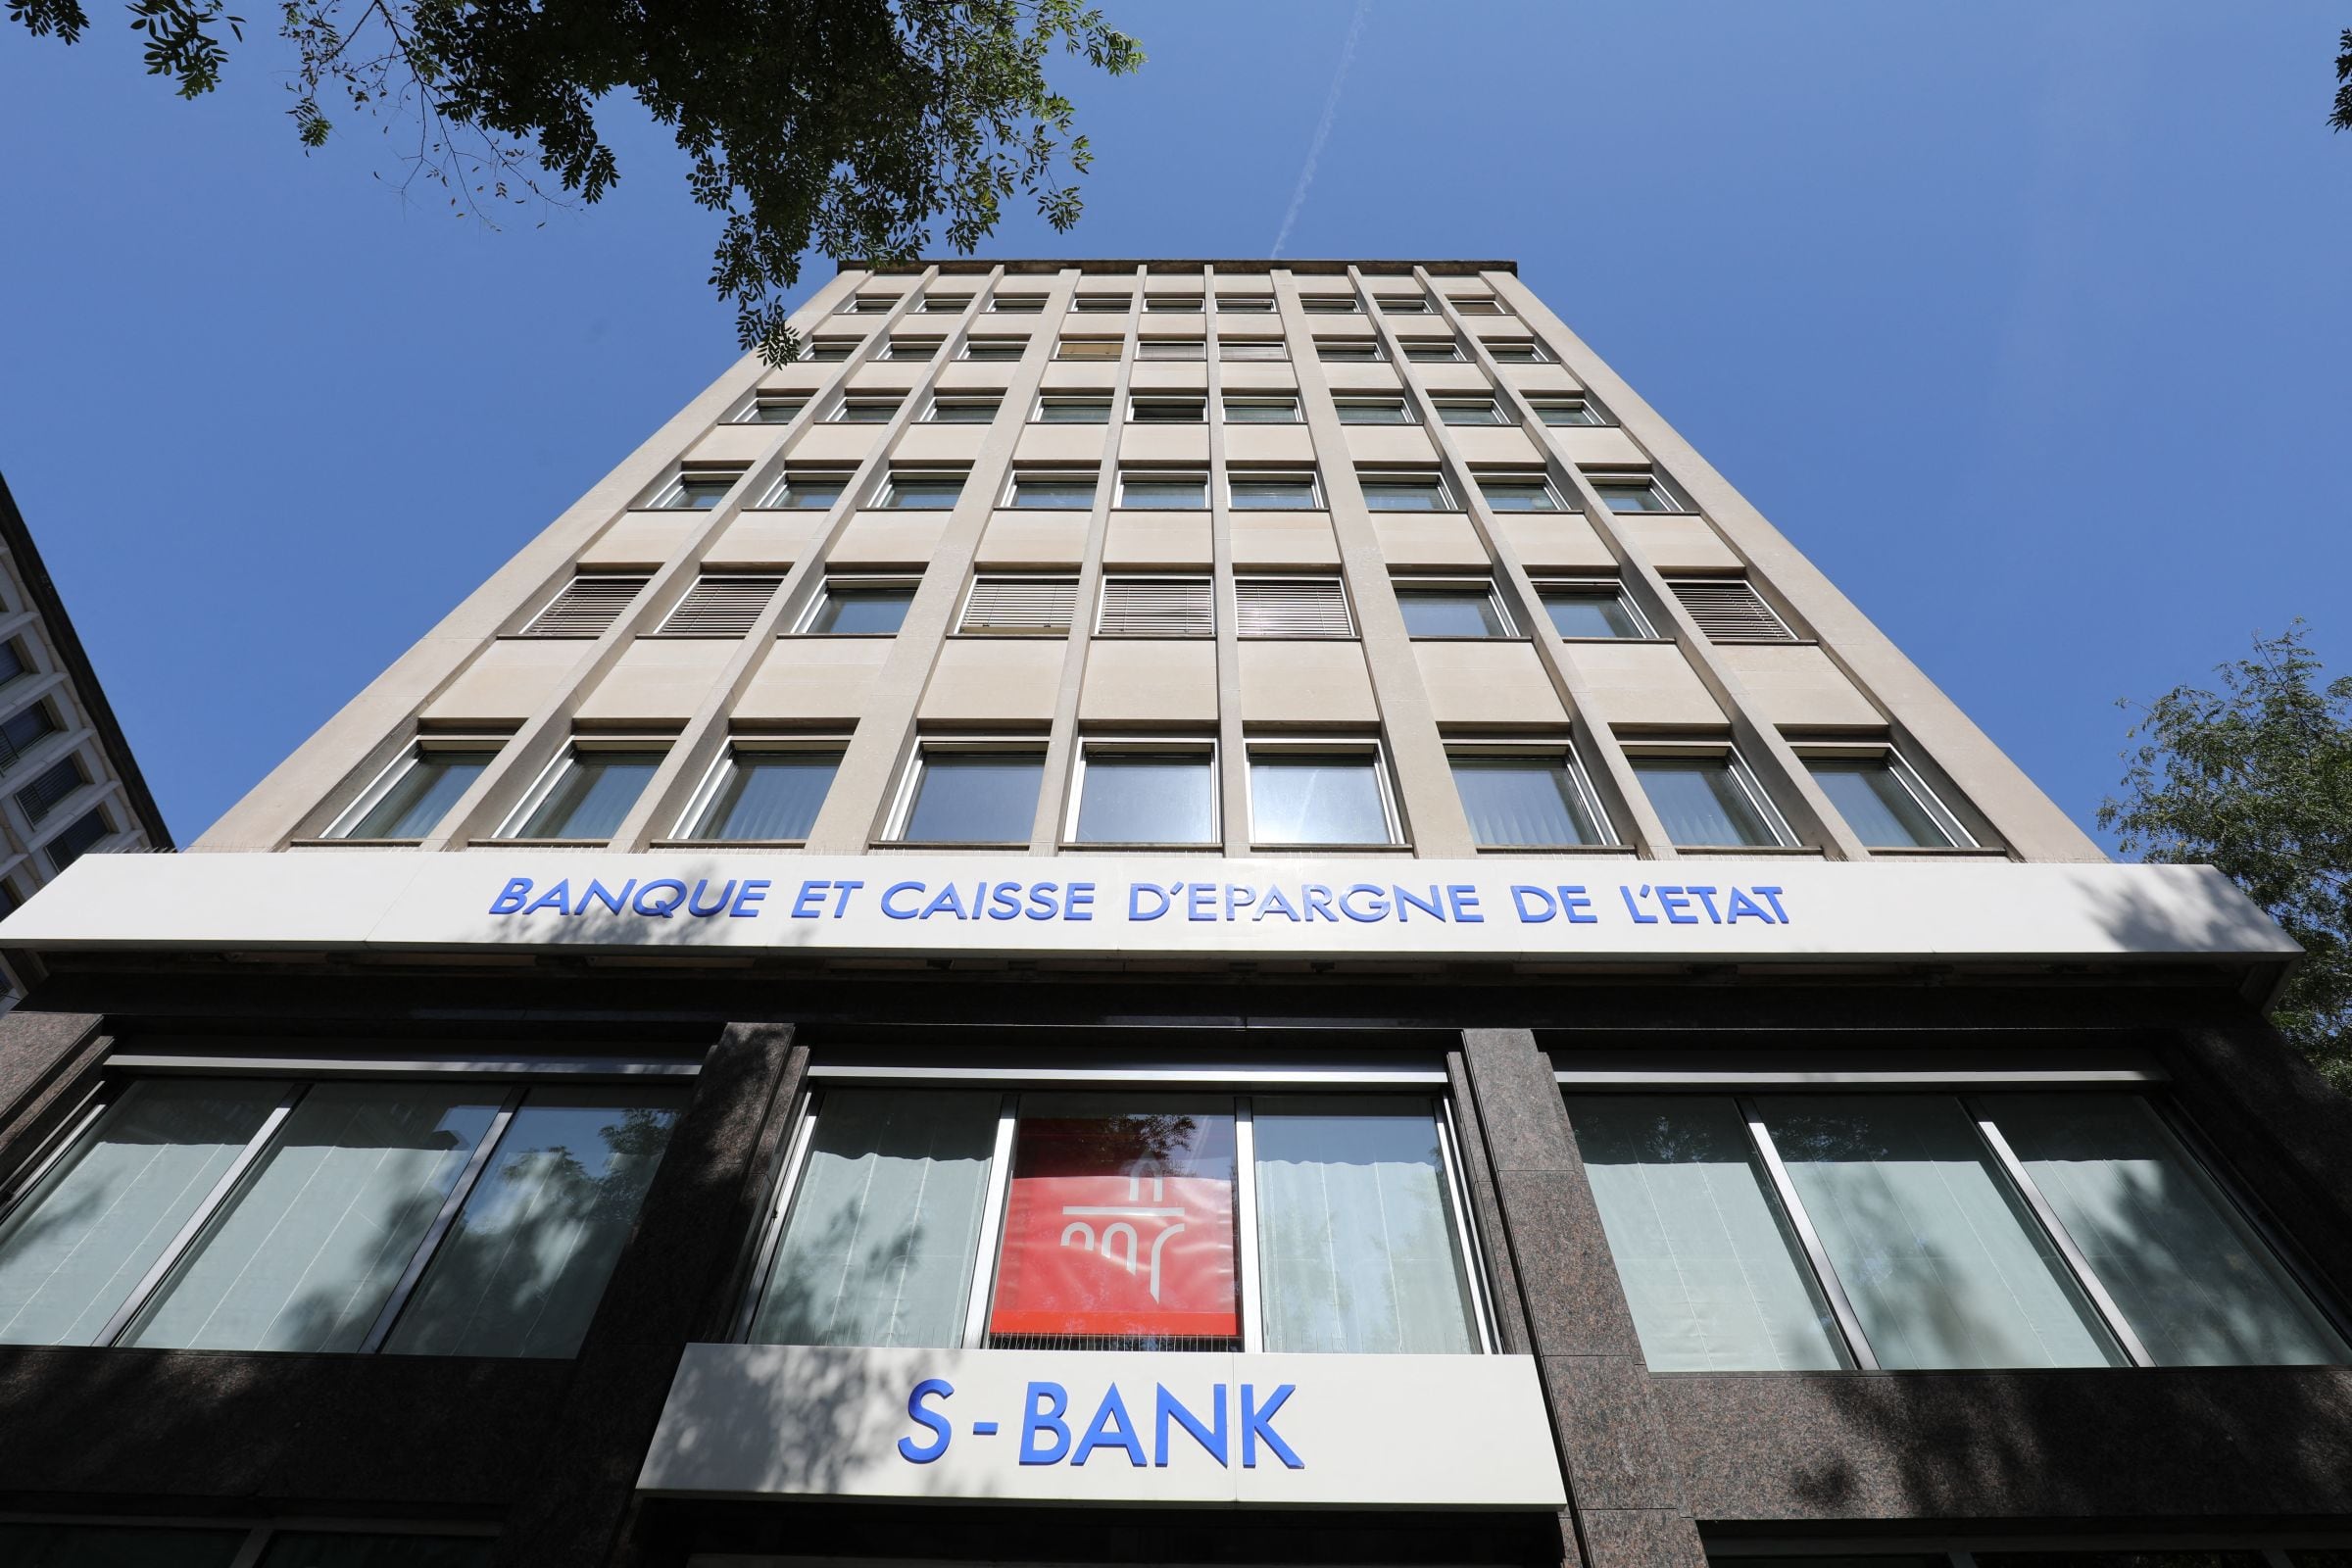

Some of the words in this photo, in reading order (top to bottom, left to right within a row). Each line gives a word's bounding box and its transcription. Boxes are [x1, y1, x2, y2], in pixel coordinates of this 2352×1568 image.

[489, 877, 770, 917] BANQUE
[792, 880, 863, 918] ET
[881, 881, 1096, 921] CAISSE
[1511, 885, 1597, 924] DE
